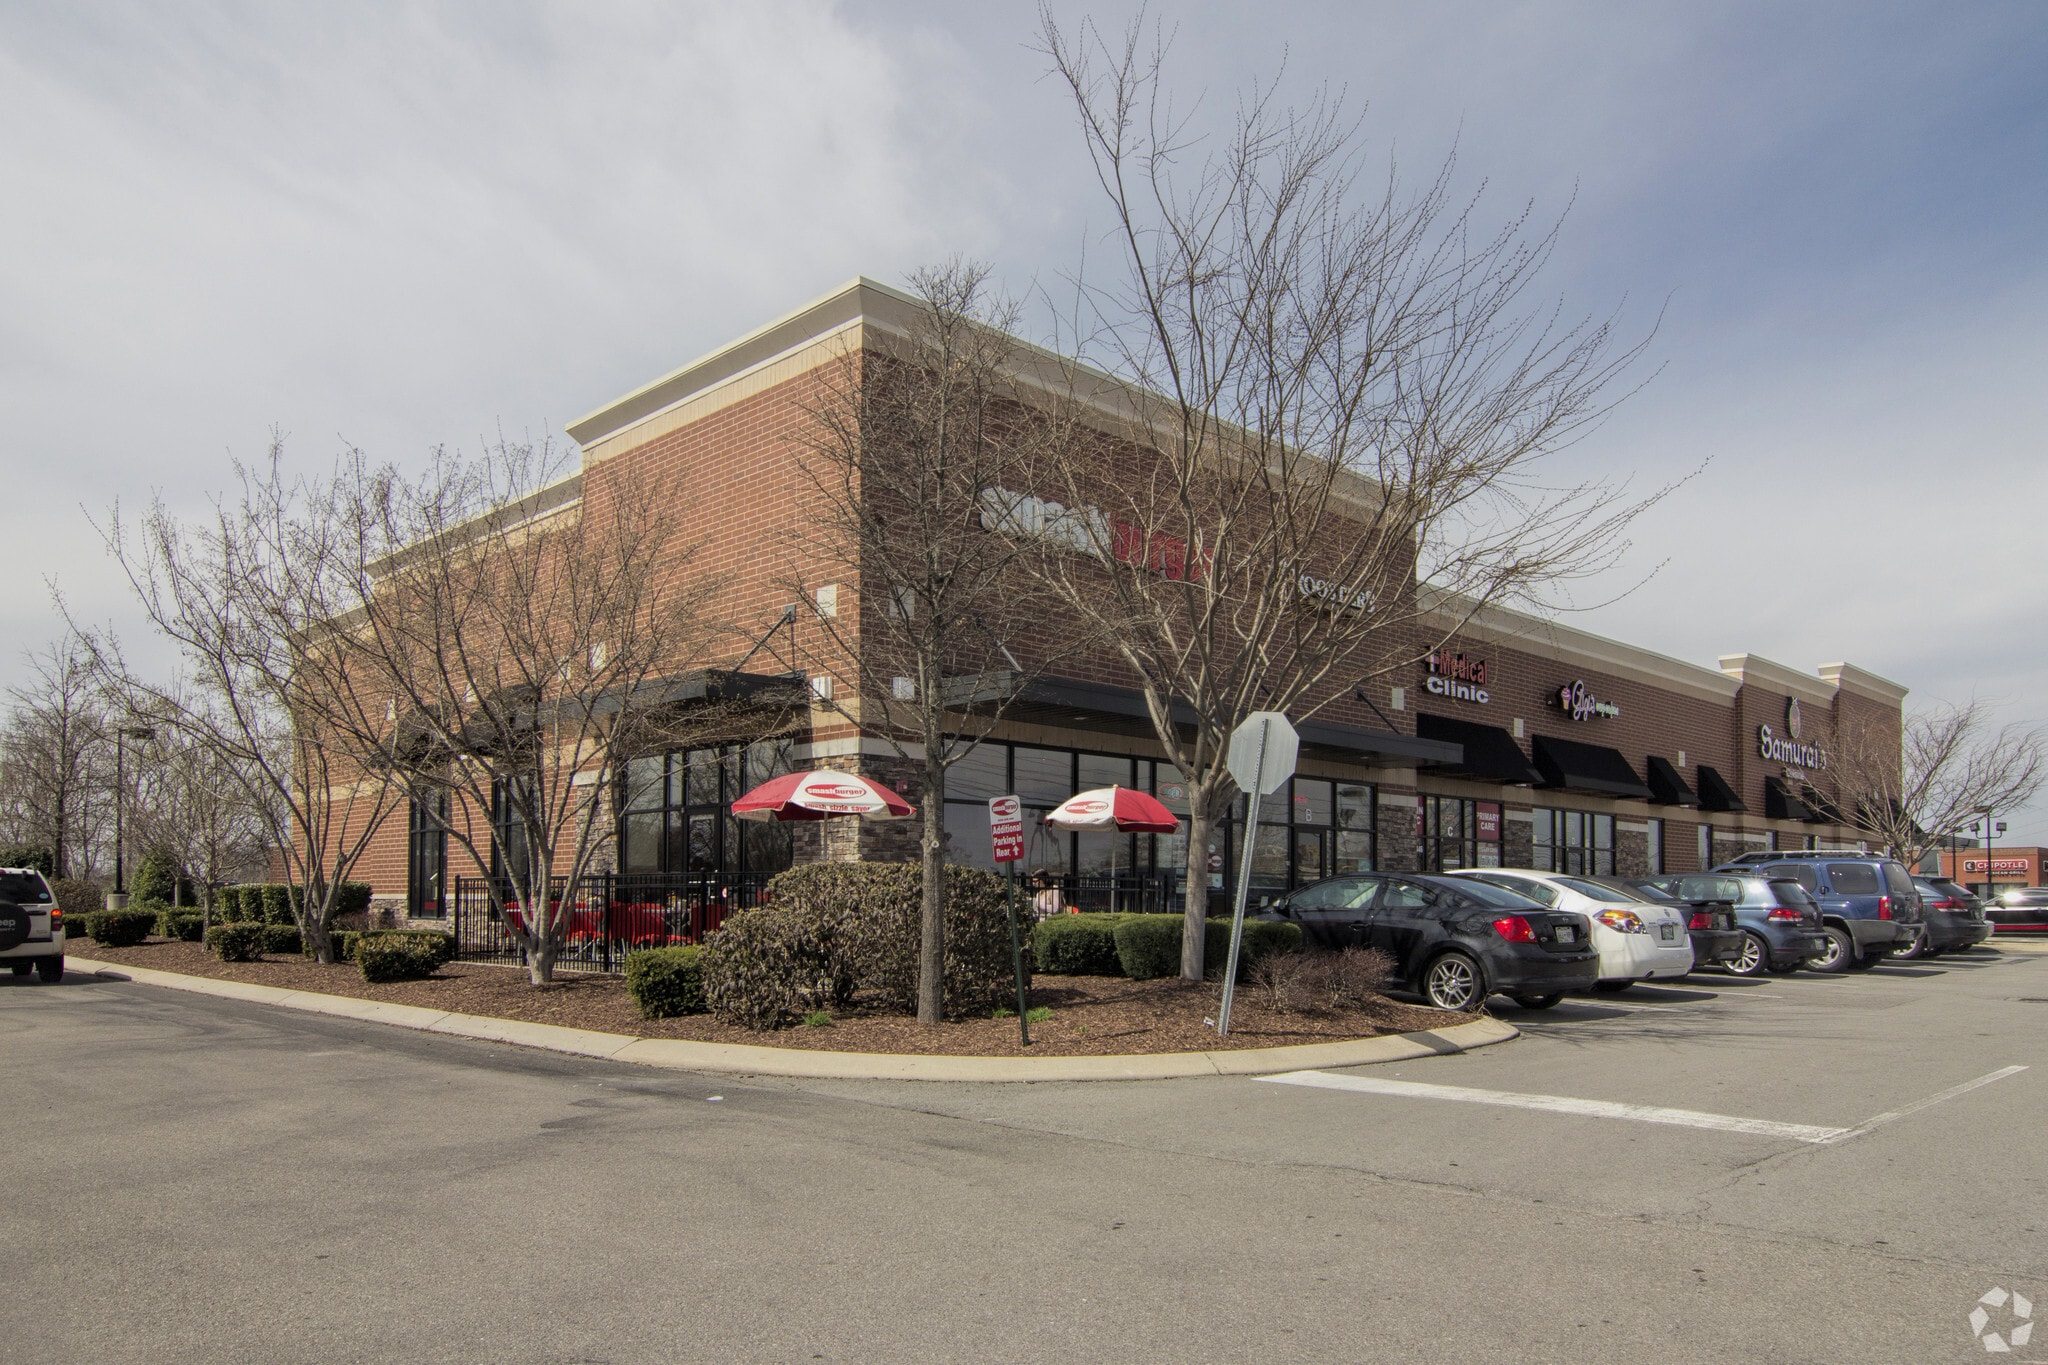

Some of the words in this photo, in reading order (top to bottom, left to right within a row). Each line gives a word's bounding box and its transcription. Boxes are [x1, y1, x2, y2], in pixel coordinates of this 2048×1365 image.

[1440, 648, 1488, 685] Medical
[1426, 676, 1489, 703] Clinic
[1572, 680, 1596, 721] Gigi's
[1761, 724, 1827, 769] Samurai's
[1306, 808, 1312, 821] B
[1477, 812, 1500, 822] PRIMARY
[992, 822, 1022, 834] Additional
[1447, 826, 1454, 837] C
[1480, 822, 1496, 831] CARE
[993, 835, 1016, 847] Parking
[1016, 833, 1023, 843] in
